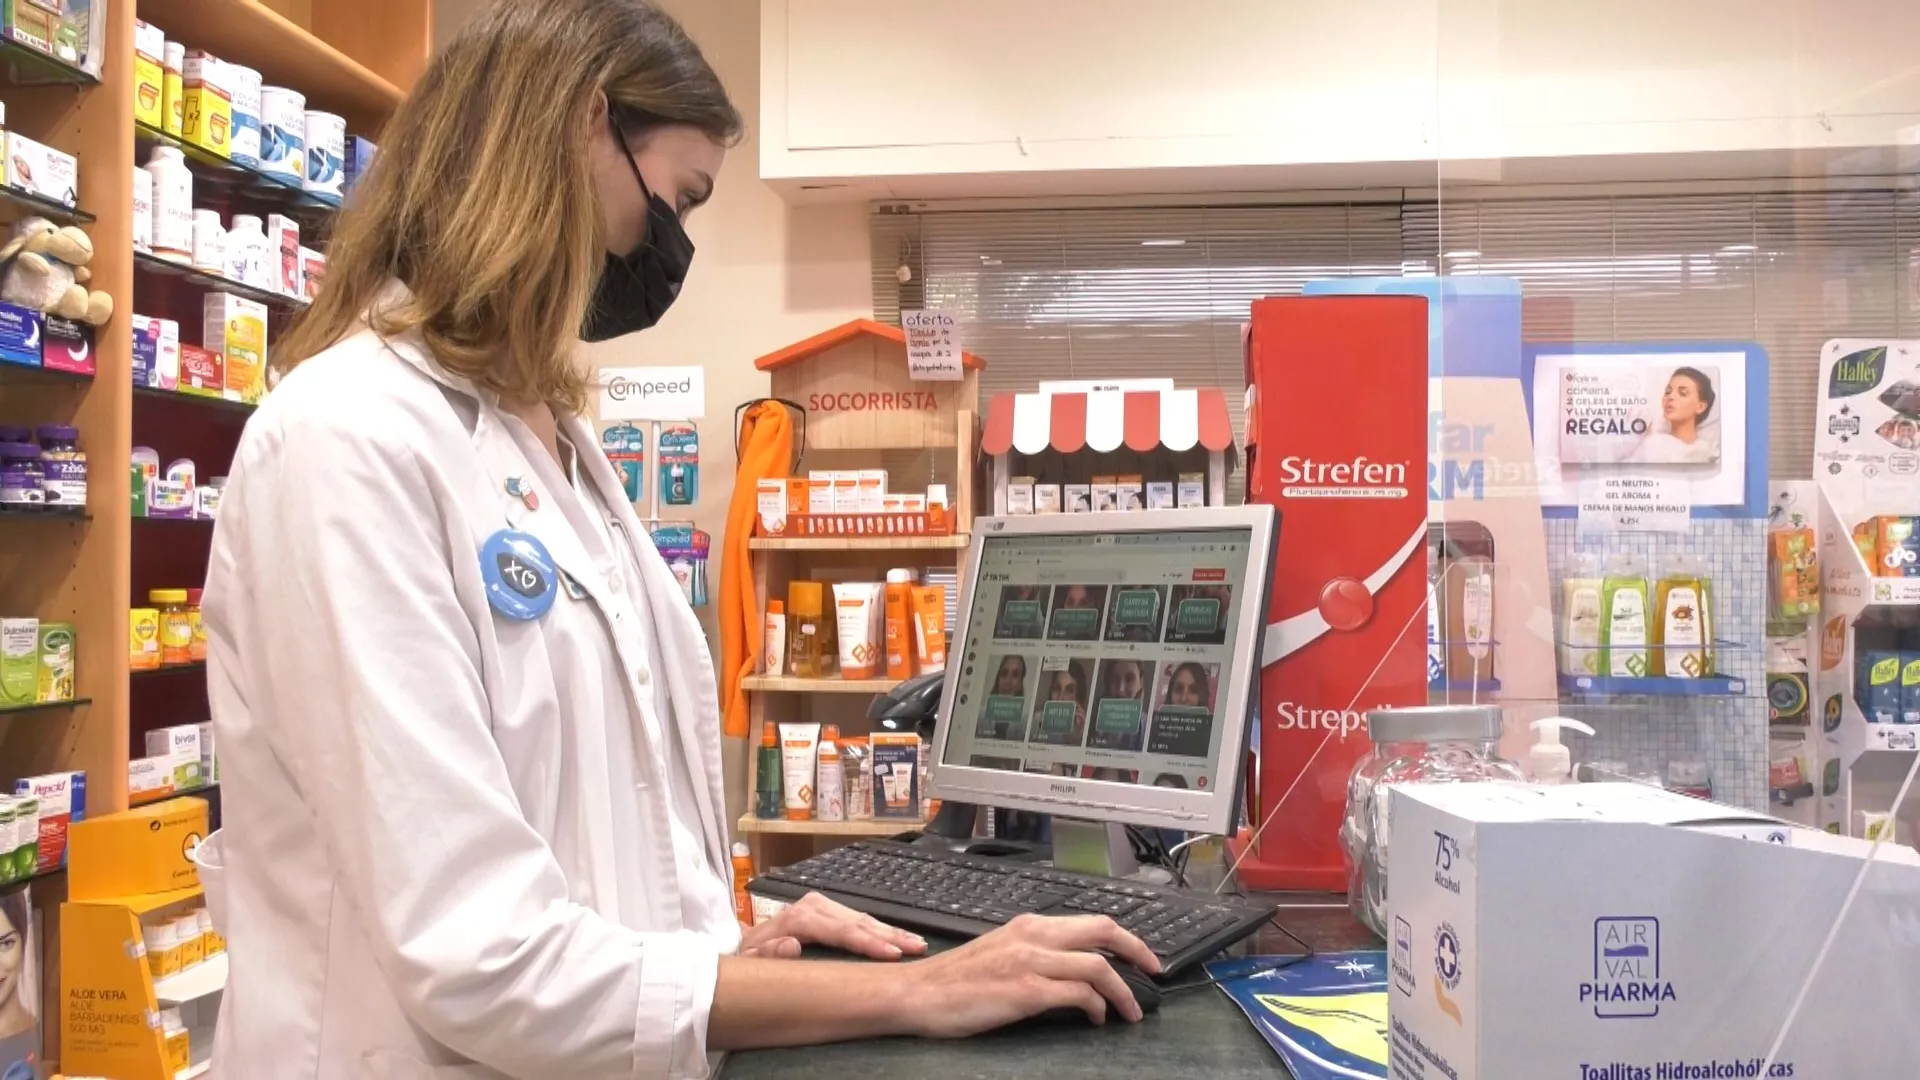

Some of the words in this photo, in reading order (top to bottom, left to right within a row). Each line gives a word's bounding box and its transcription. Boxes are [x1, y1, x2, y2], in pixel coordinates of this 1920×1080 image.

[906, 312, 954, 326] oferta
[1837, 361, 1877, 387] Halley
[608, 376, 690, 401] Compeed
[809, 392, 938, 411] SOCORRISTA
[1566, 418, 1647, 435] REGALO
[1280, 455, 1406, 484] Strefen
[1277, 701, 1392, 738] Streps
[1050, 784, 1076, 793] PHILIPS
[1435, 871, 1460, 895] Alcohol
[1605, 924, 1647, 944] AIR
[1604, 959, 1648, 979] VAL
[69, 989, 96, 999] ALOE
[98, 990, 127, 1001] VERA
[1579, 982, 1677, 1003] PHARMA
[69, 1000, 94, 1011] ALOE
[1580, 1063, 1651, 1080] Toallitas
